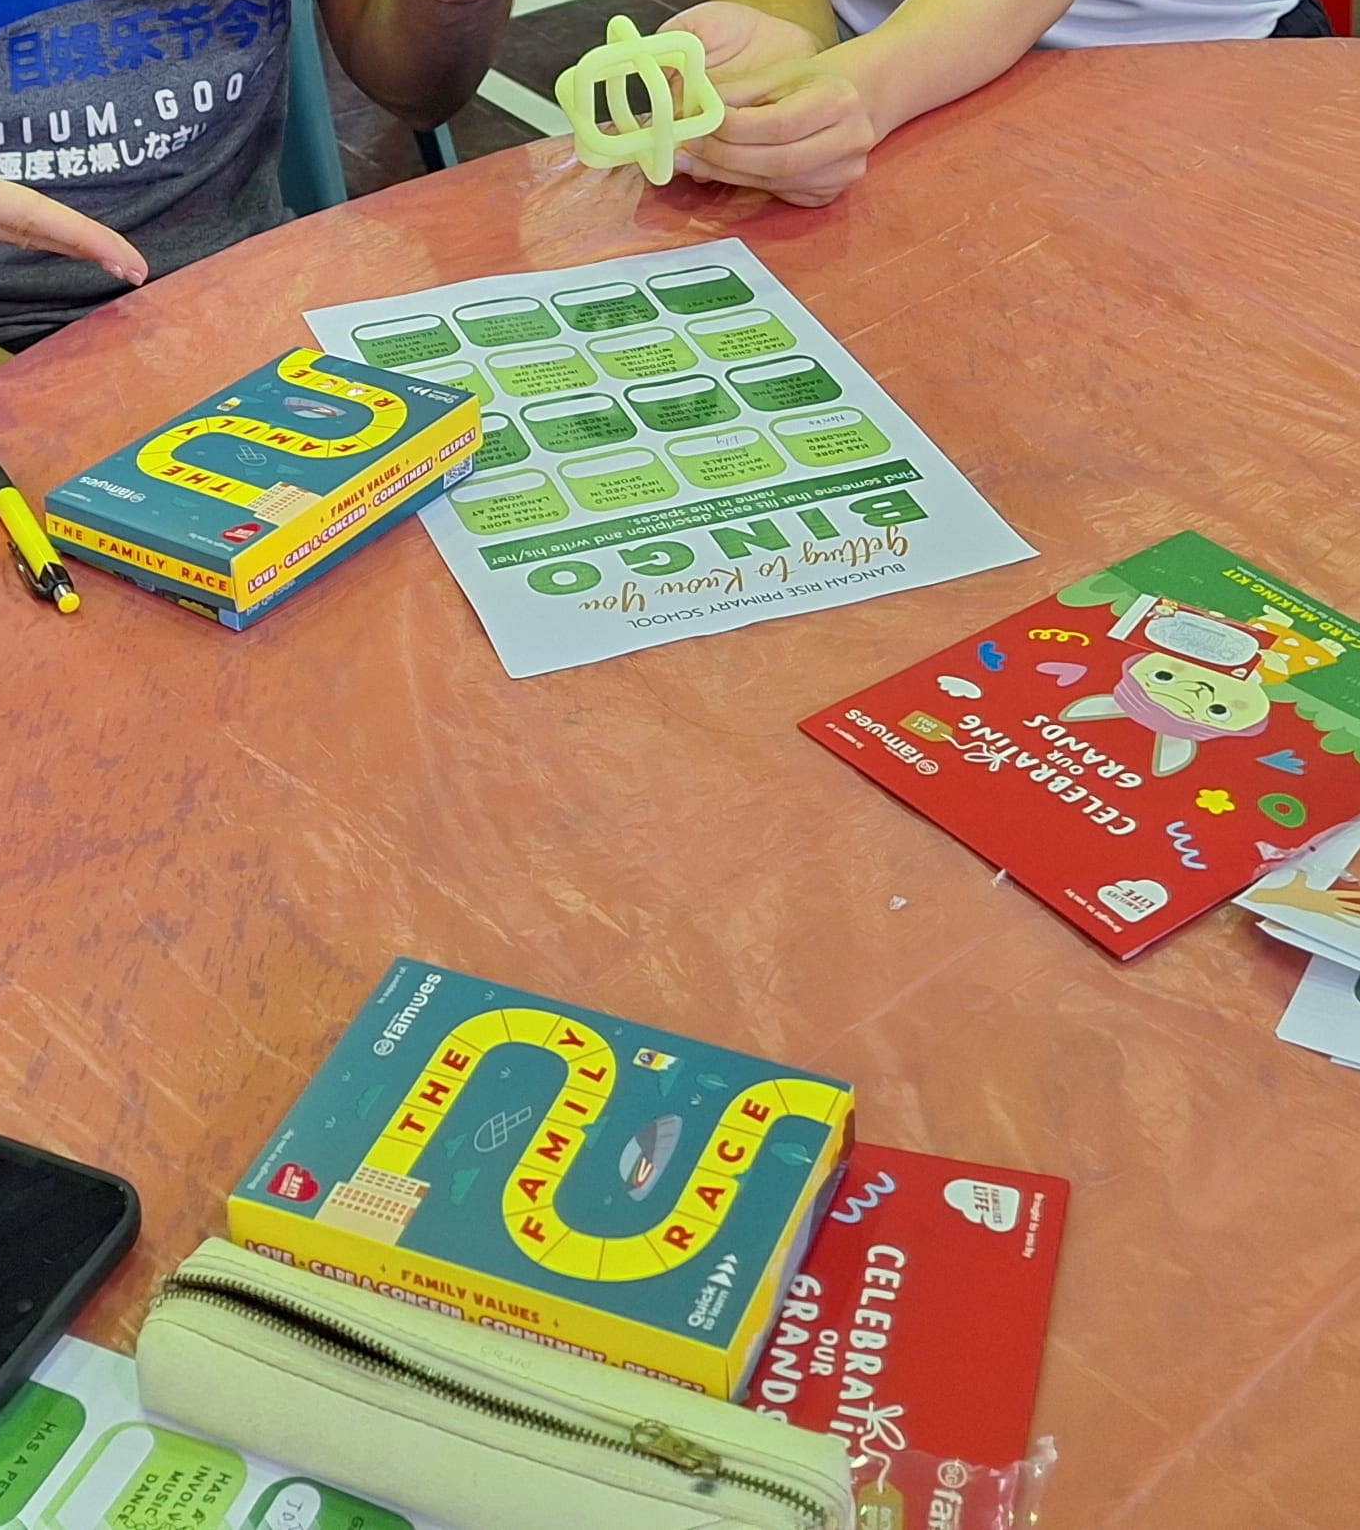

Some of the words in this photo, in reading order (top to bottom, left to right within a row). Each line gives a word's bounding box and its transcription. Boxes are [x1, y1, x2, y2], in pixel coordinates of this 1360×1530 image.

[814, 447, 842, 458] MORE
[835, 436, 863, 447] THAN
[163, 464, 227, 493] THE
[703, 469, 734, 481] CHILD
[884, 468, 918, 483] Find
[329, 489, 365, 518] FAMILY
[366, 464, 401, 492] VALUES
[594, 493, 627, 504] CHILD
[605, 480, 659, 494] INVOLVED
[735, 490, 777, 504] name
[780, 490, 814, 504] that
[814, 477, 881, 497] someone
[248, 564, 277, 593] LOVE
[320, 504, 367, 542] CONCERN
[372, 457, 433, 508] COMMITMENT
[438, 429, 477, 462] RESPECT
[493, 495, 550, 512] LANGUAGE
[518, 505, 544, 515] THAN
[689, 501, 715, 514] the
[718, 498, 732, 507] in
[720, 503, 753, 518] each
[757, 497, 780, 510] fits
[479, 519, 511, 530] MORE
[515, 510, 559, 522] SPEAKS
[626, 507, 687, 526] spaces.
[626, 508, 719, 536] description
[551, 538, 590, 552] write
[593, 532, 622, 544] and
[797, 526, 910, 573] Getting
[52, 522, 84, 541] THE
[98, 539, 166, 570] FAMILY
[181, 567, 227, 592] RACE
[490, 544, 549, 568] his/her
[754, 556, 796, 582] to
[824, 563, 906, 588] BLANGAH
[1222, 568, 1252, 587] KIT
[653, 567, 745, 600] Know
[786, 581, 821, 598] RISE
[576, 582, 646, 613] You
[707, 589, 784, 614] PRIMARY
[1250, 582, 1318, 624] MAKING
[626, 607, 704, 629] SCHOOL
[1022, 714, 1143, 789] GRANDS
[1045, 749, 1084, 776] OUR
[398, 1048, 472, 1138] THE
[519, 1026, 608, 1246] FAMILY
[662, 1097, 772, 1253] RACE
[245, 1240, 296, 1267] LOVE
[400, 1269, 469, 1300] FAMILY
[472, 1291, 542, 1325] VALUES
[687, 1283, 718, 1327] Quick
[708, 1290, 729, 1317] learn
[702, 1317, 715, 1330] to
[809, 1327, 839, 1378] OUR
[26, 1420, 59, 1455] HAS
[15, 1454, 29, 1467] A
[210, 1470, 233, 1505] HAS
